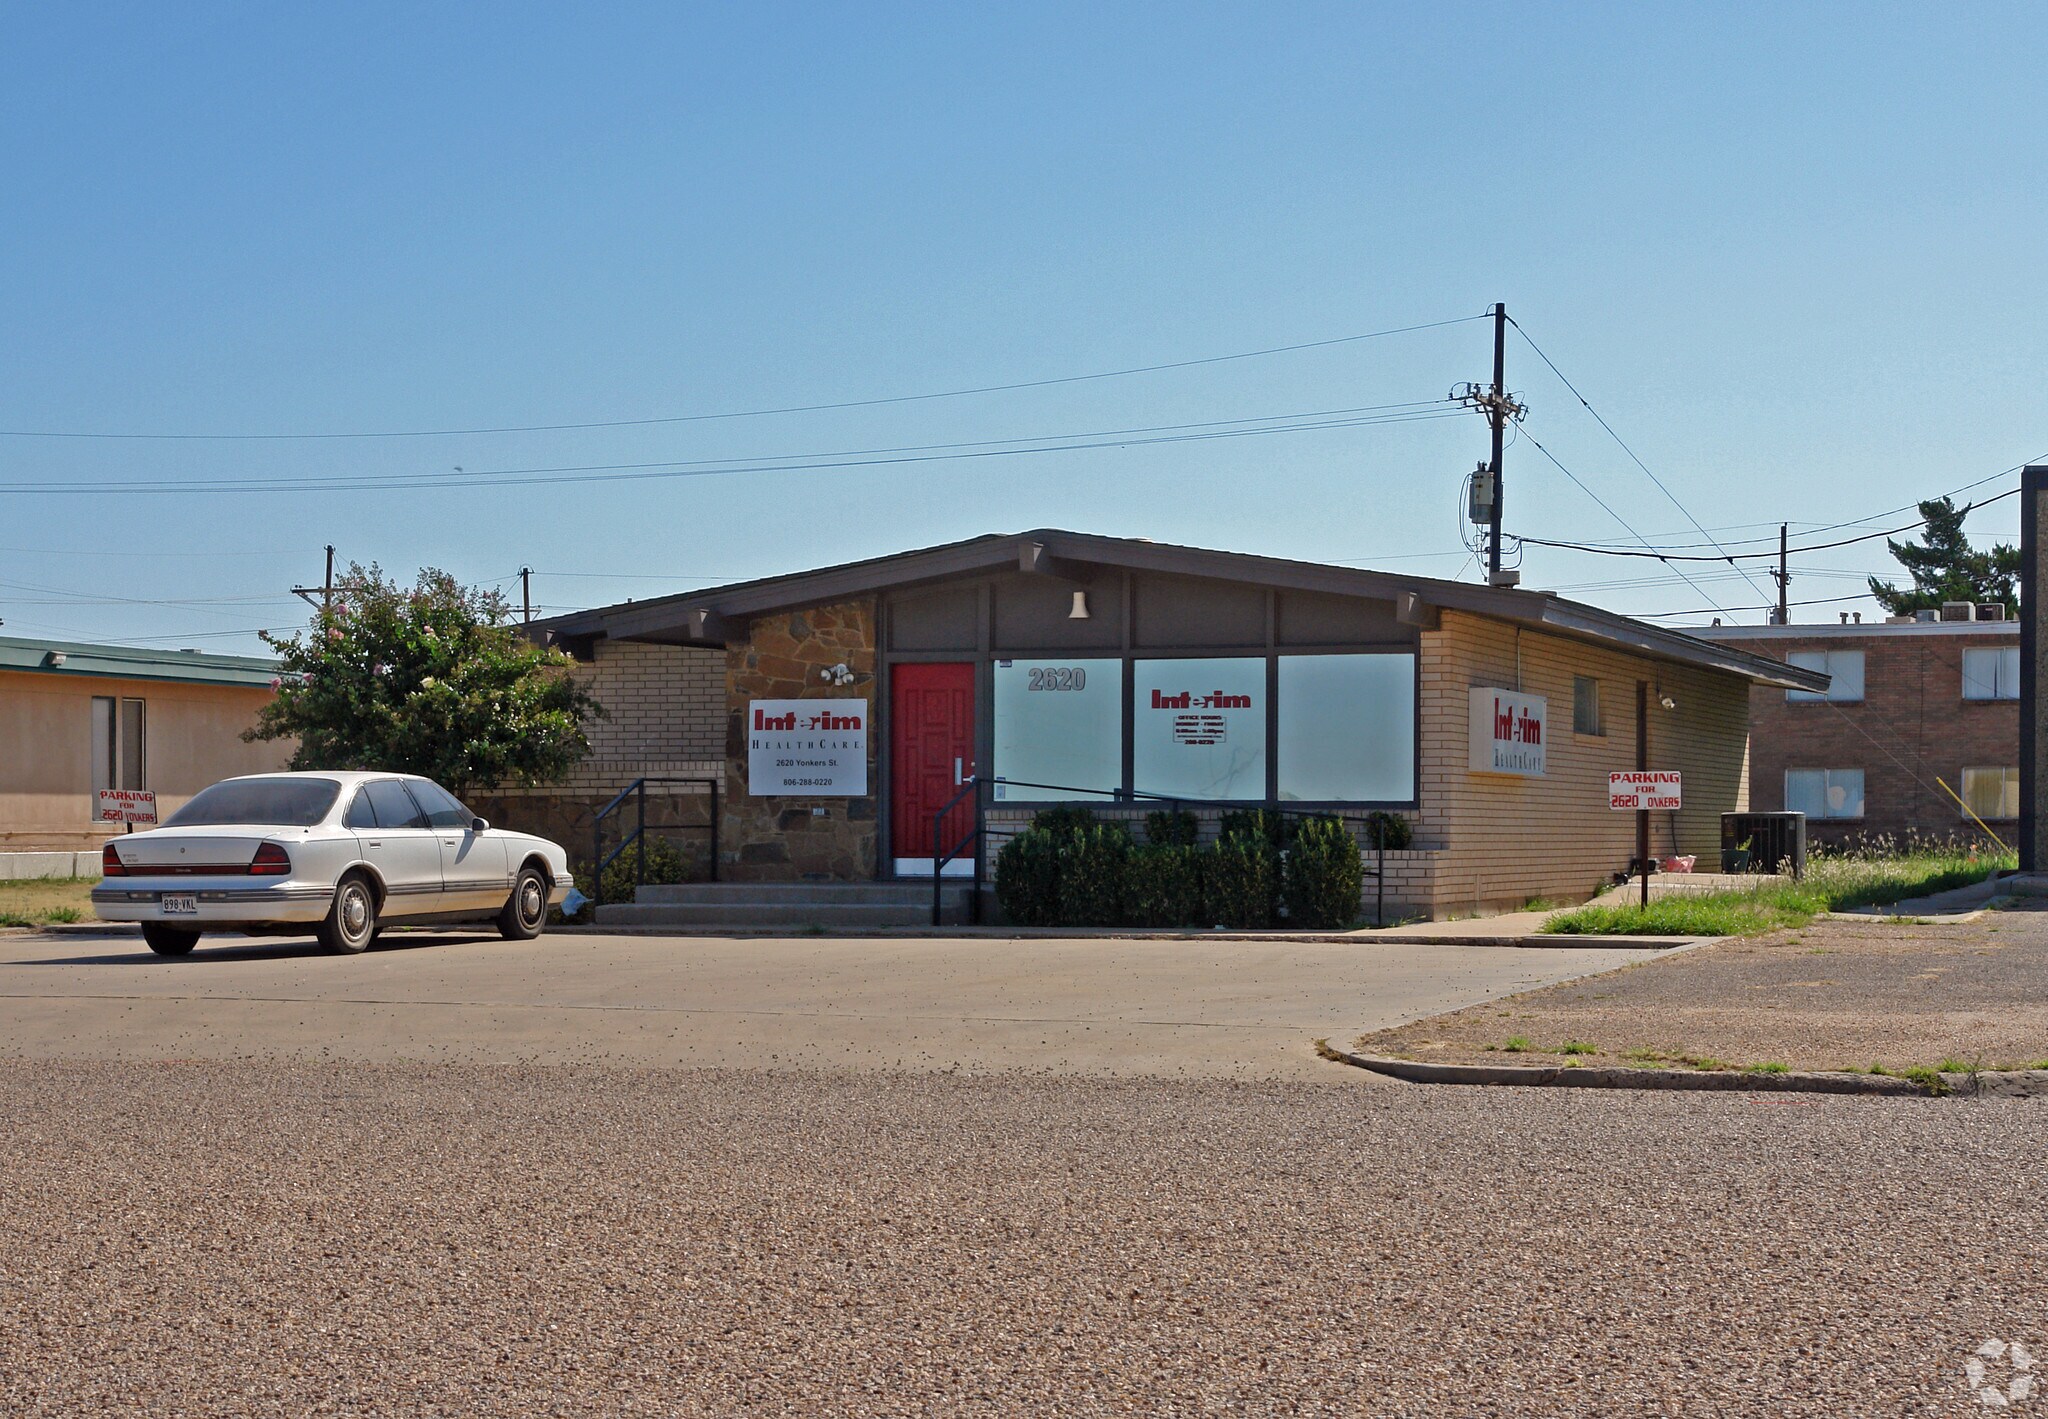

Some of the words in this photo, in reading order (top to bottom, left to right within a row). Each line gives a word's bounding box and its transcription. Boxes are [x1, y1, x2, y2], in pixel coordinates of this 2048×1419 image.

[1028, 667, 1086, 691] 2620
[796, 759, 827, 767] Yonkers
[828, 759, 839, 767] St.
[1611, 773, 1680, 783] PARKING
[1635, 785, 1656, 793] FOR
[100, 790, 153, 802] PARKING
[1611, 794, 1639, 808] 2620
[102, 809, 123, 821] 2620
